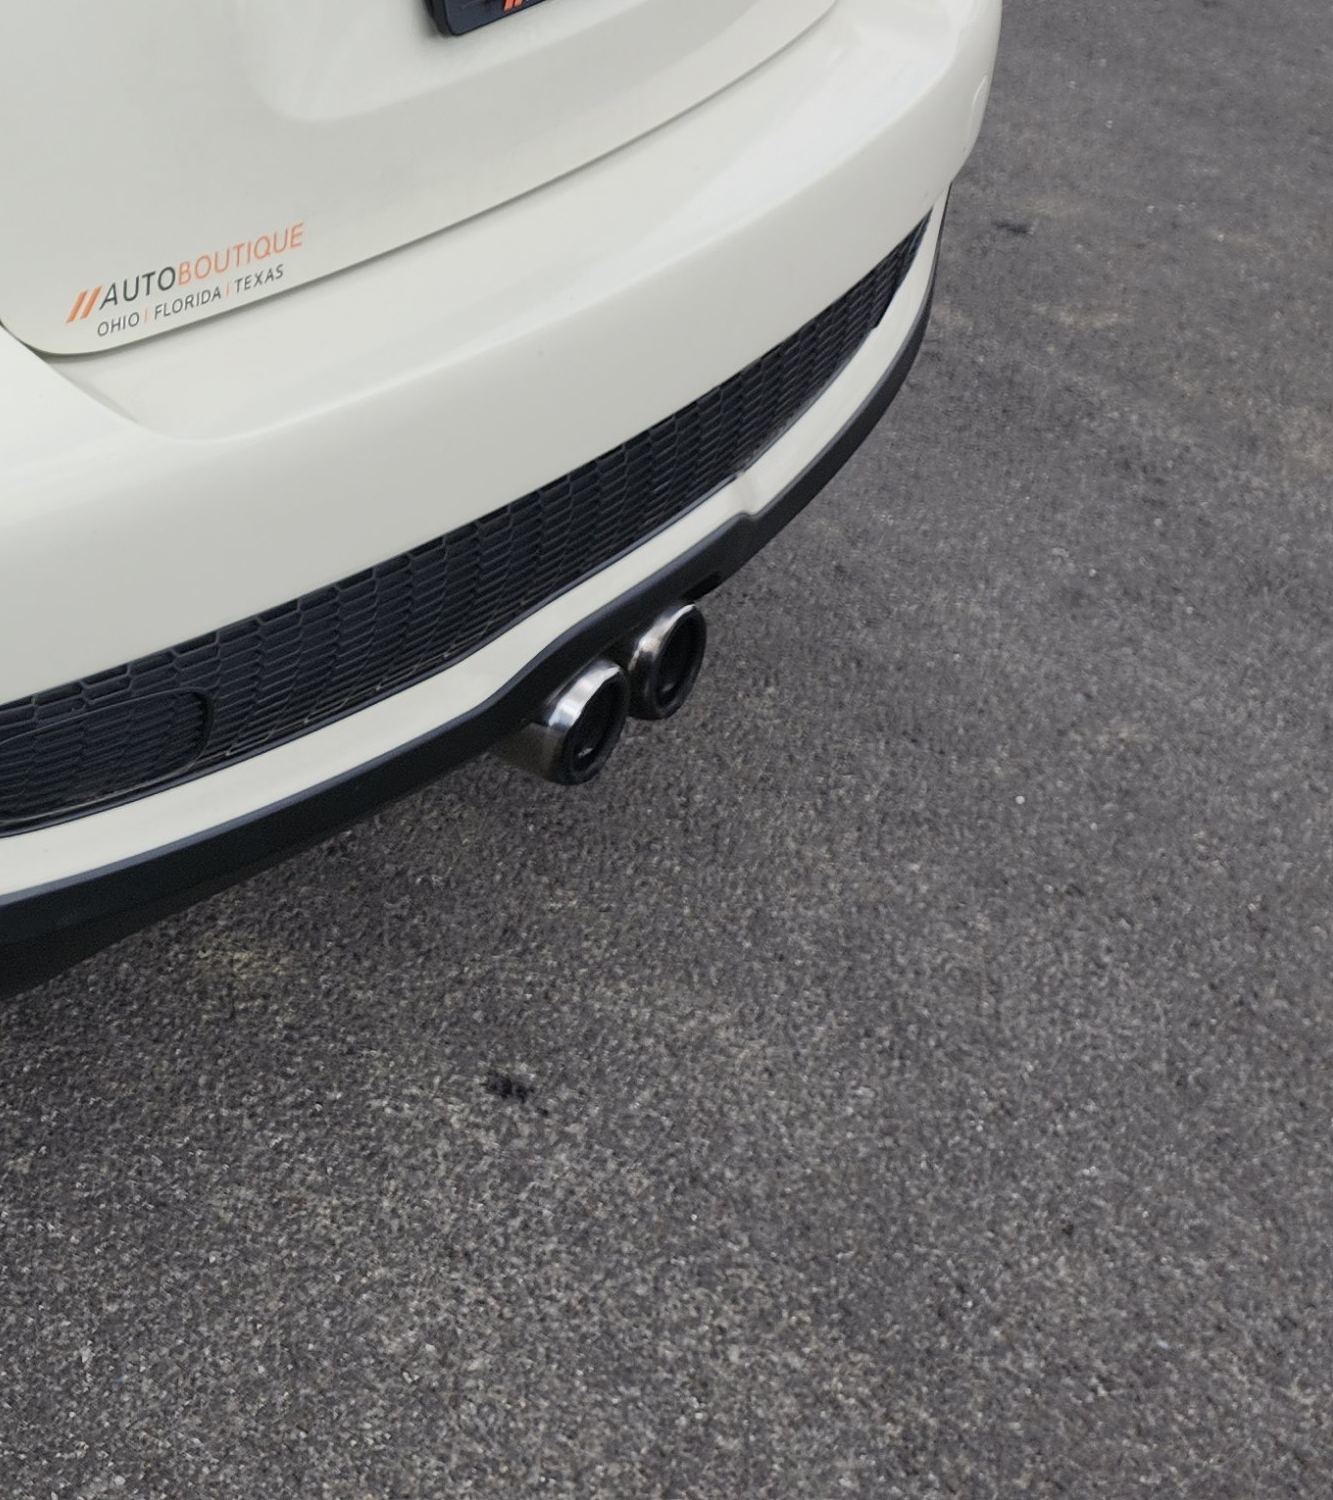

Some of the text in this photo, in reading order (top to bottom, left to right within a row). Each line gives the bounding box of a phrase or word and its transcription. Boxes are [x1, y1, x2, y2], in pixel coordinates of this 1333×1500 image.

[96, 263, 285, 337] OHIO FLORIDA TEXAS
